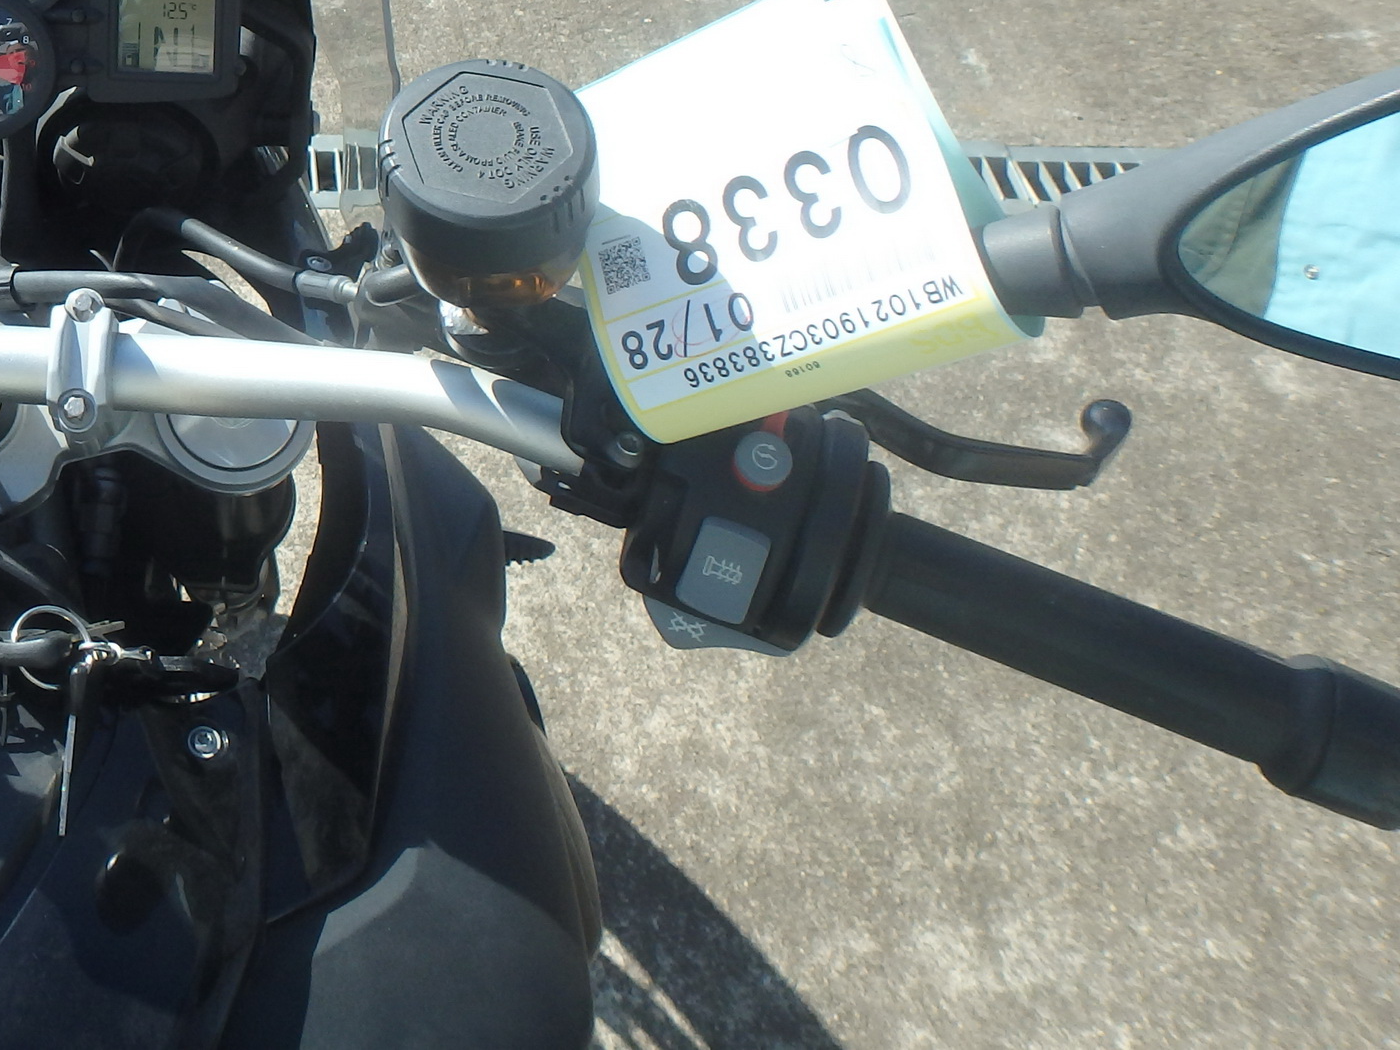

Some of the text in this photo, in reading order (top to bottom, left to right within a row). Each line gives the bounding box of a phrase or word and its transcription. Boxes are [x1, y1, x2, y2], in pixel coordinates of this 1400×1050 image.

[6, 17, 13, 26] 7
[22, 35, 30, 44] 8
[419, 85, 468, 125] WARNING
[529, 126, 541, 146] USE
[488, 166, 514, 180] DOT
[504, 147, 556, 189] WARNING
[516, 147, 538, 172] ONLY
[661, 124, 912, 286] 0338
[621, 292, 755, 371] 01/28
[683, 274, 964, 388] WB1021903CZ383836
